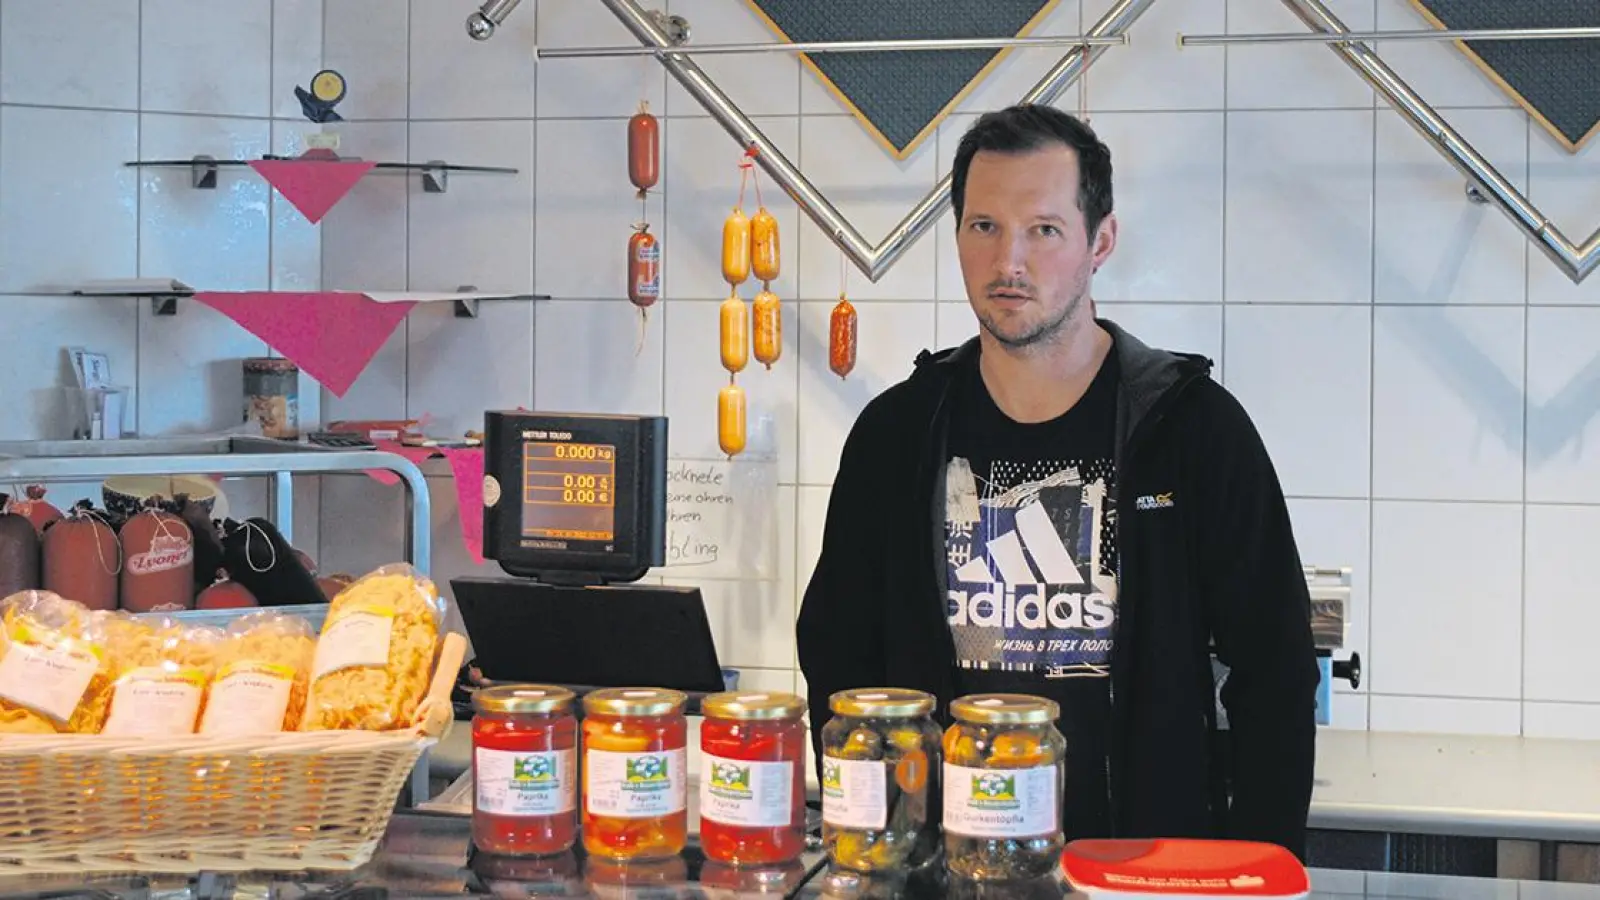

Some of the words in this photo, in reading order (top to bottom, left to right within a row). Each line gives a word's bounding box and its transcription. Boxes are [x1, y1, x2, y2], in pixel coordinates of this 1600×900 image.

[549, 432, 572, 440] TOLEDO
[555, 445, 596, 459] 0.000
[597, 447, 611, 459] kg
[563, 474, 595, 488] 0.00
[563, 489, 595, 502] 0.00
[947, 582, 1115, 628] adidas
[993, 639, 1034, 652] ЖИЗНЬ
[1036, 639, 1046, 652] В
[1046, 639, 1079, 652] ТРЕХ
